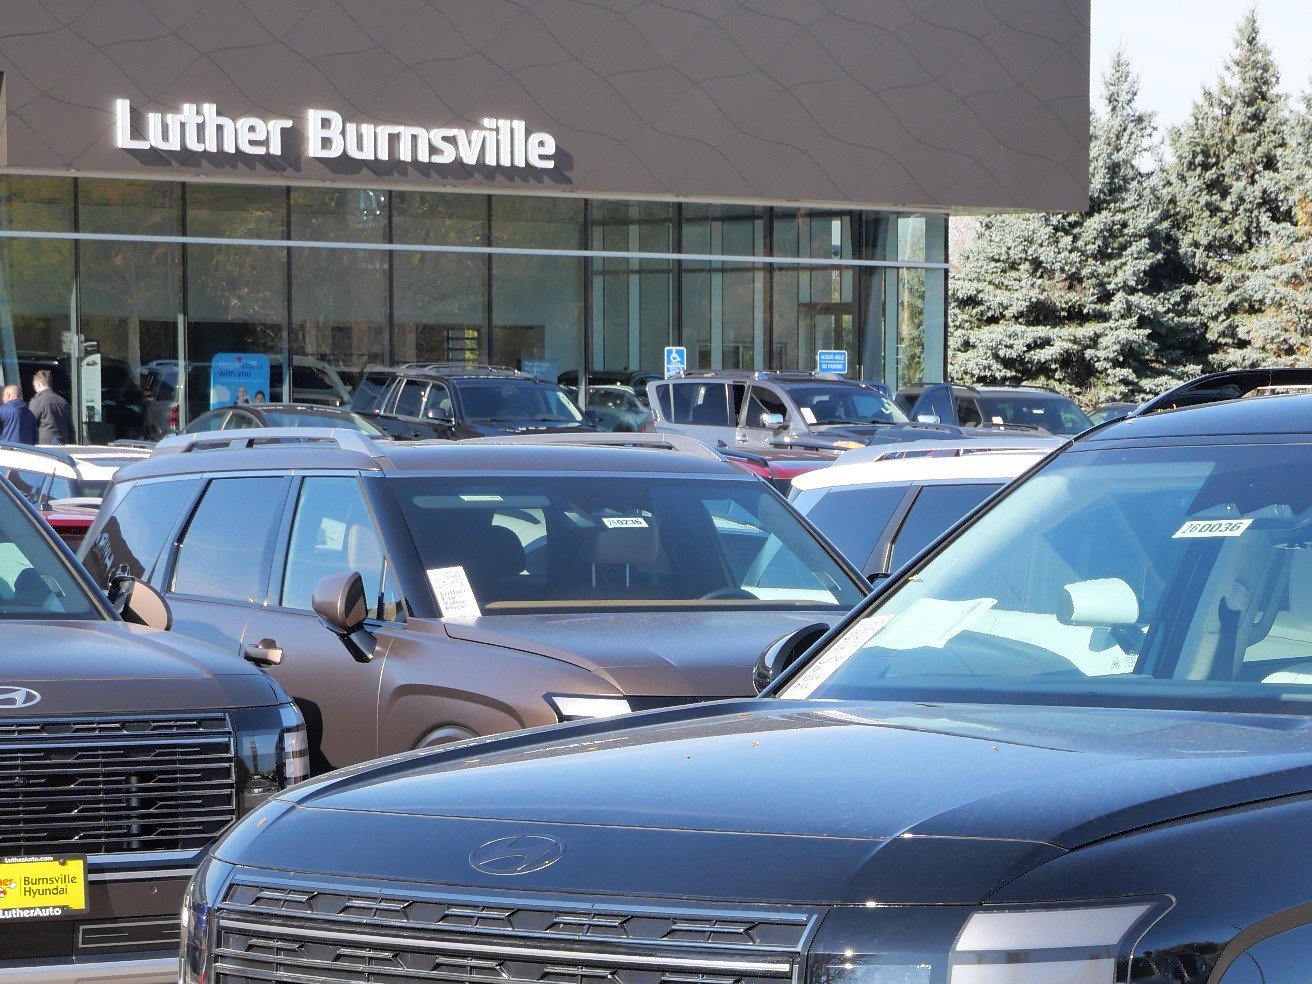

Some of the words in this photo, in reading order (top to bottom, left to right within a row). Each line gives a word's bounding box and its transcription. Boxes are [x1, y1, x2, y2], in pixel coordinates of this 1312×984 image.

[116, 98, 293, 156] Luther
[307, 108, 556, 169] Burnsville
[218, 369, 236, 378] with
[237, 370, 252, 379] you
[5, 856, 54, 864] LutherAuto.com
[23, 873, 77, 886] Burnsville
[24, 885, 68, 898] Hyundai
[0, 907, 61, 918] LutherAuto
